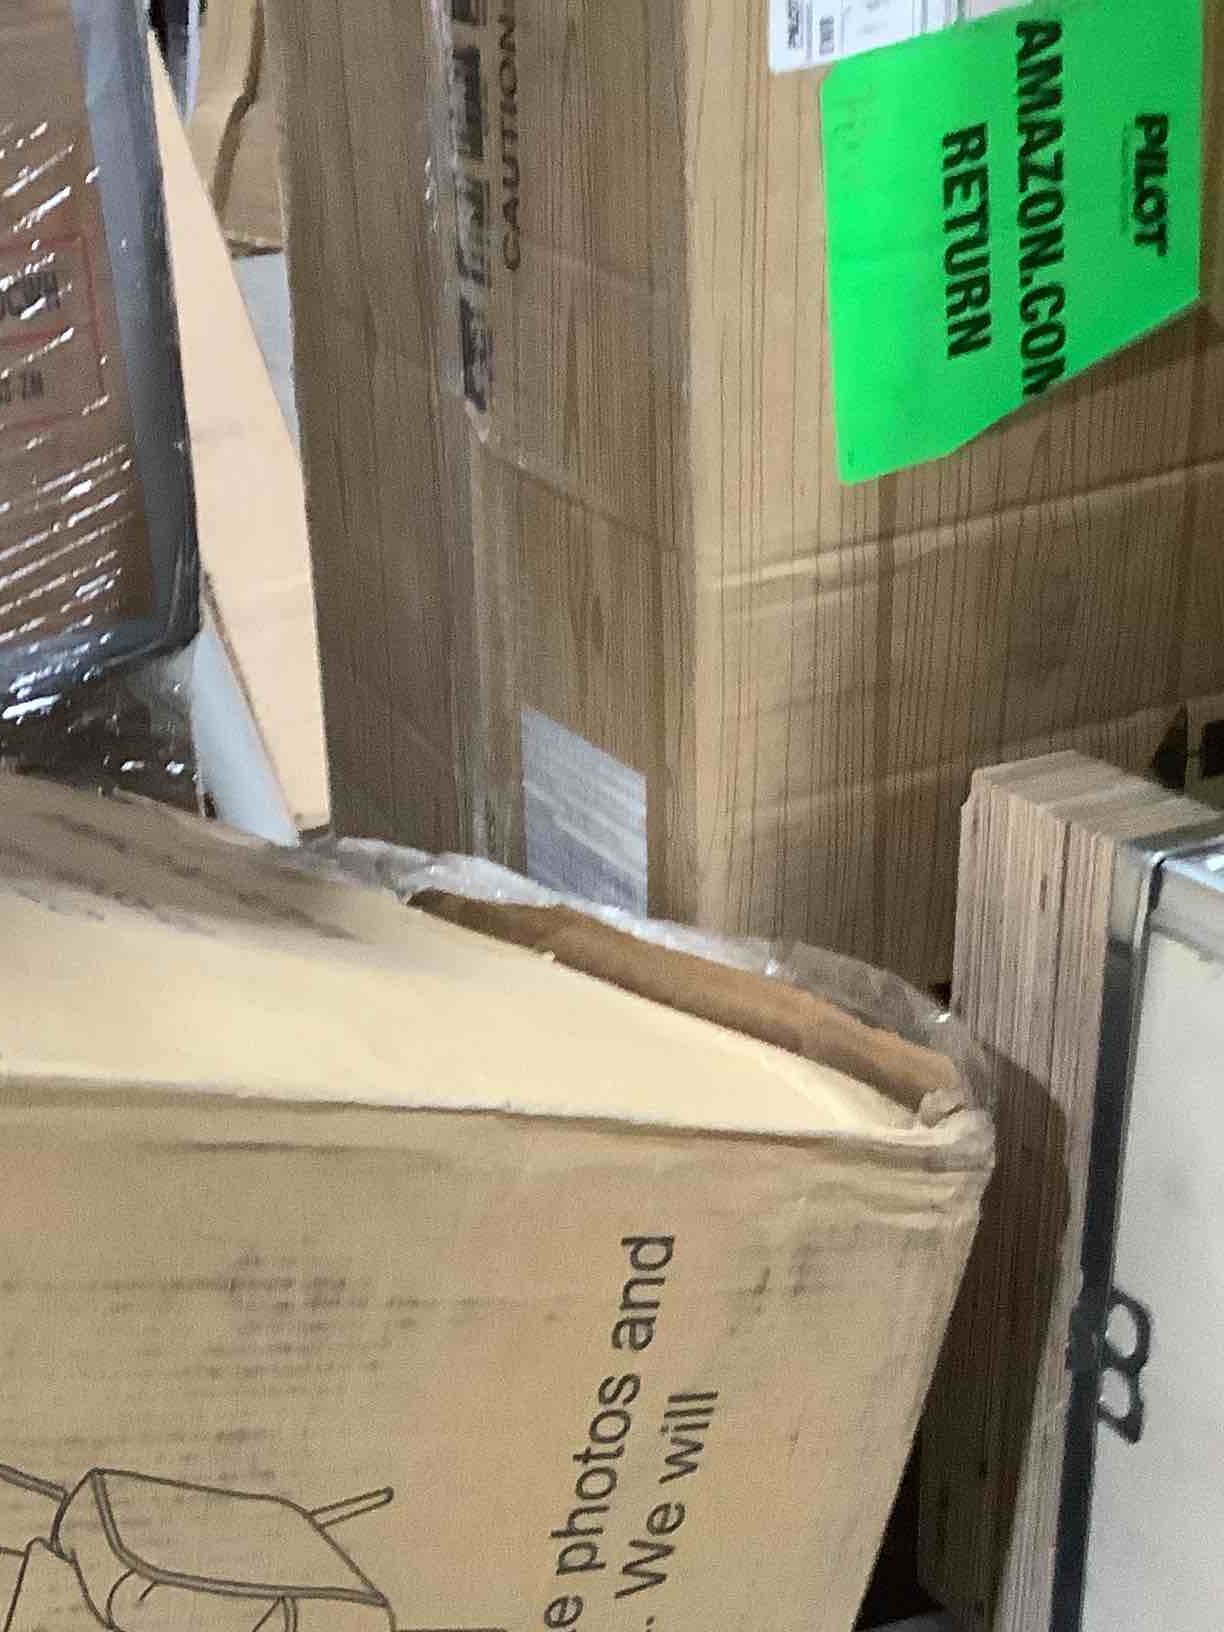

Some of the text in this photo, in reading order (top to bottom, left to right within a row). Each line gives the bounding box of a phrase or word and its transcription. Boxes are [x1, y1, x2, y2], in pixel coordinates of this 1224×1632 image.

[942, 122, 992, 360] RETURN
[1133, 112, 1169, 257] PILOT
[550, 1372, 641, 1575] photos
[611, 1234, 676, 1352] and
[615, 1501, 686, 1600] We
[659, 1390, 719, 1485] will
